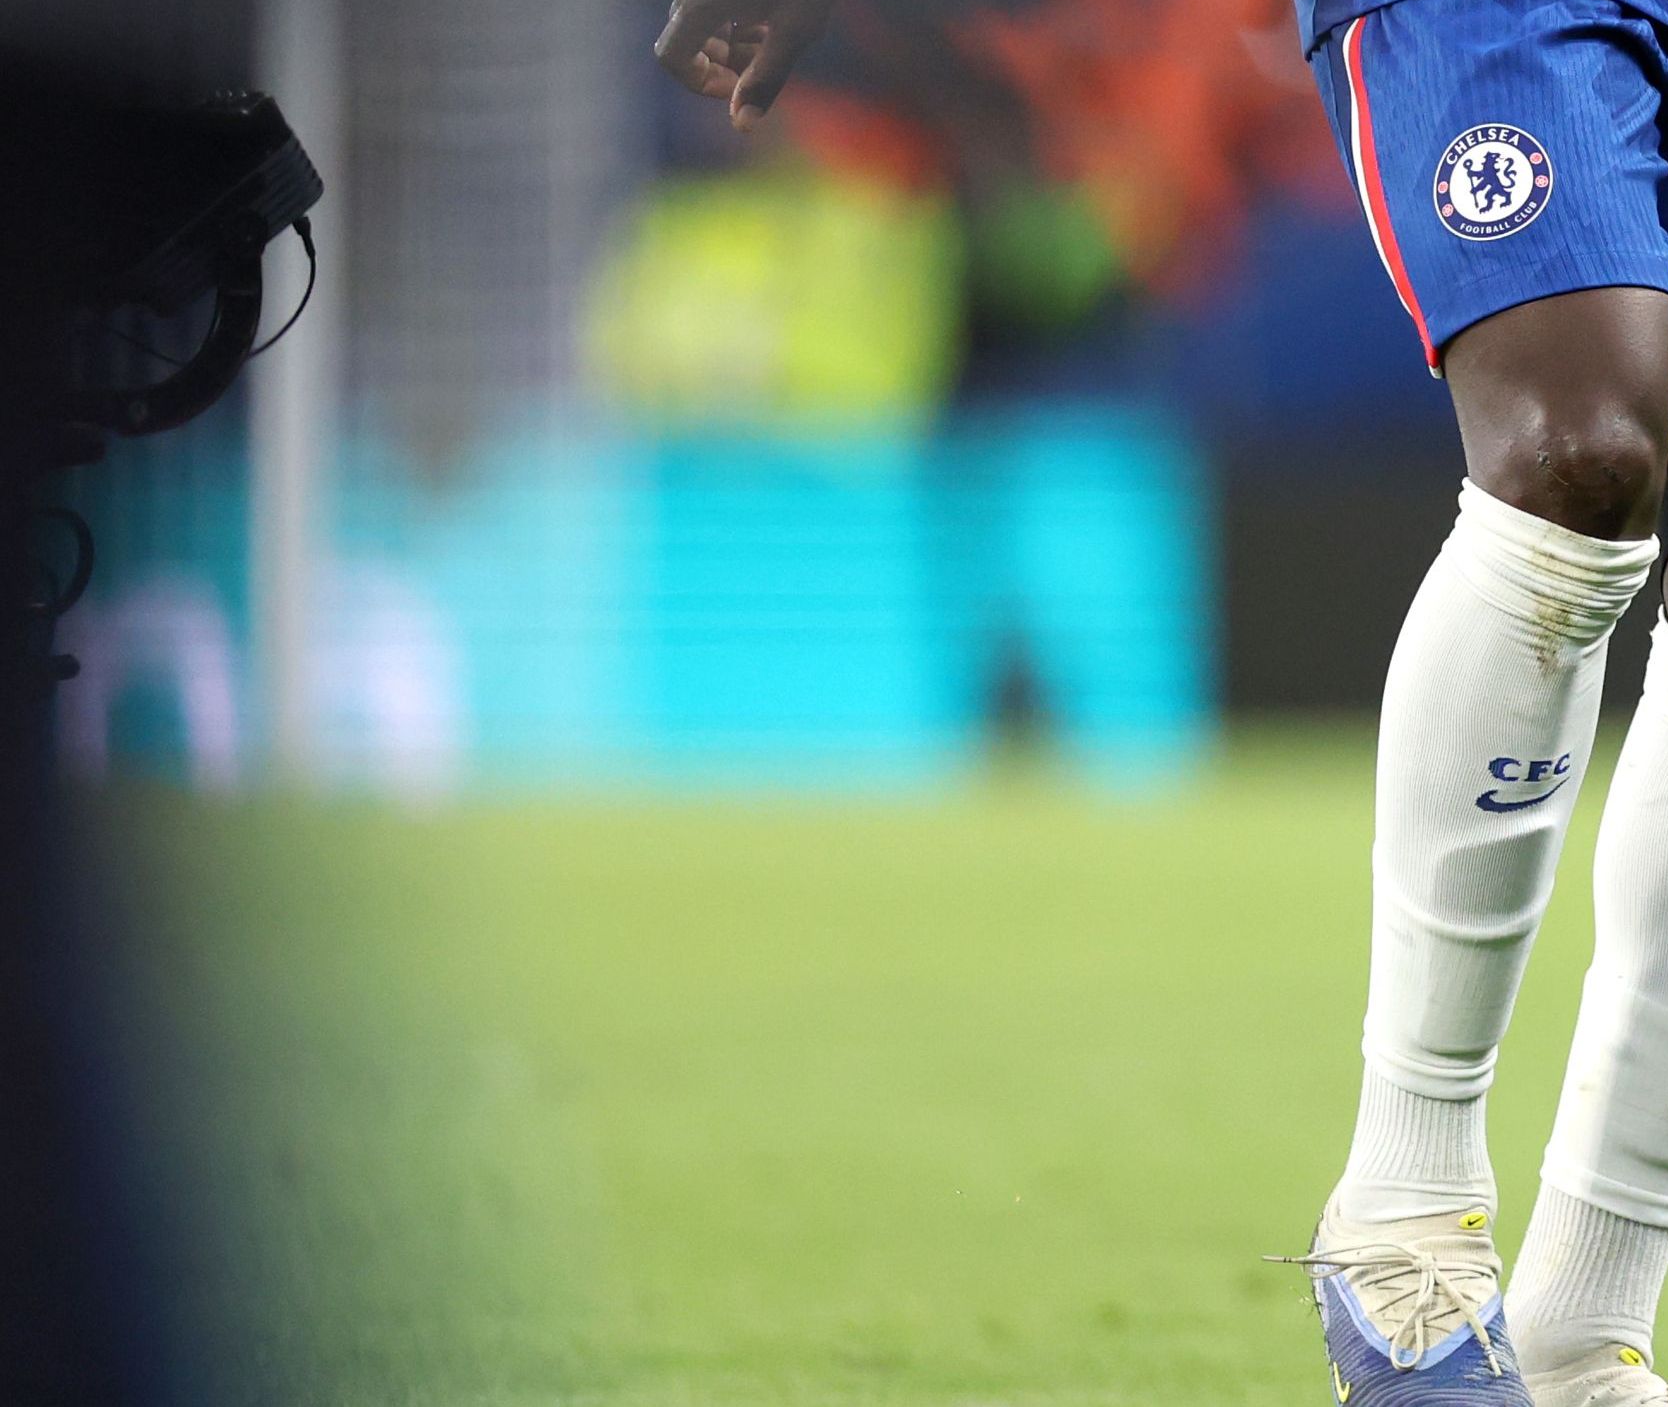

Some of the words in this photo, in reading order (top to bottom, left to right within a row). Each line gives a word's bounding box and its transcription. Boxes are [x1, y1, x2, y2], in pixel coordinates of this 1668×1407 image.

[1446, 128, 1520, 165] CHELSEA
[1460, 221, 1511, 234] FOOTBALL
[1514, 200, 1538, 223] CLUB
[1488, 753, 1571, 782] CFC
